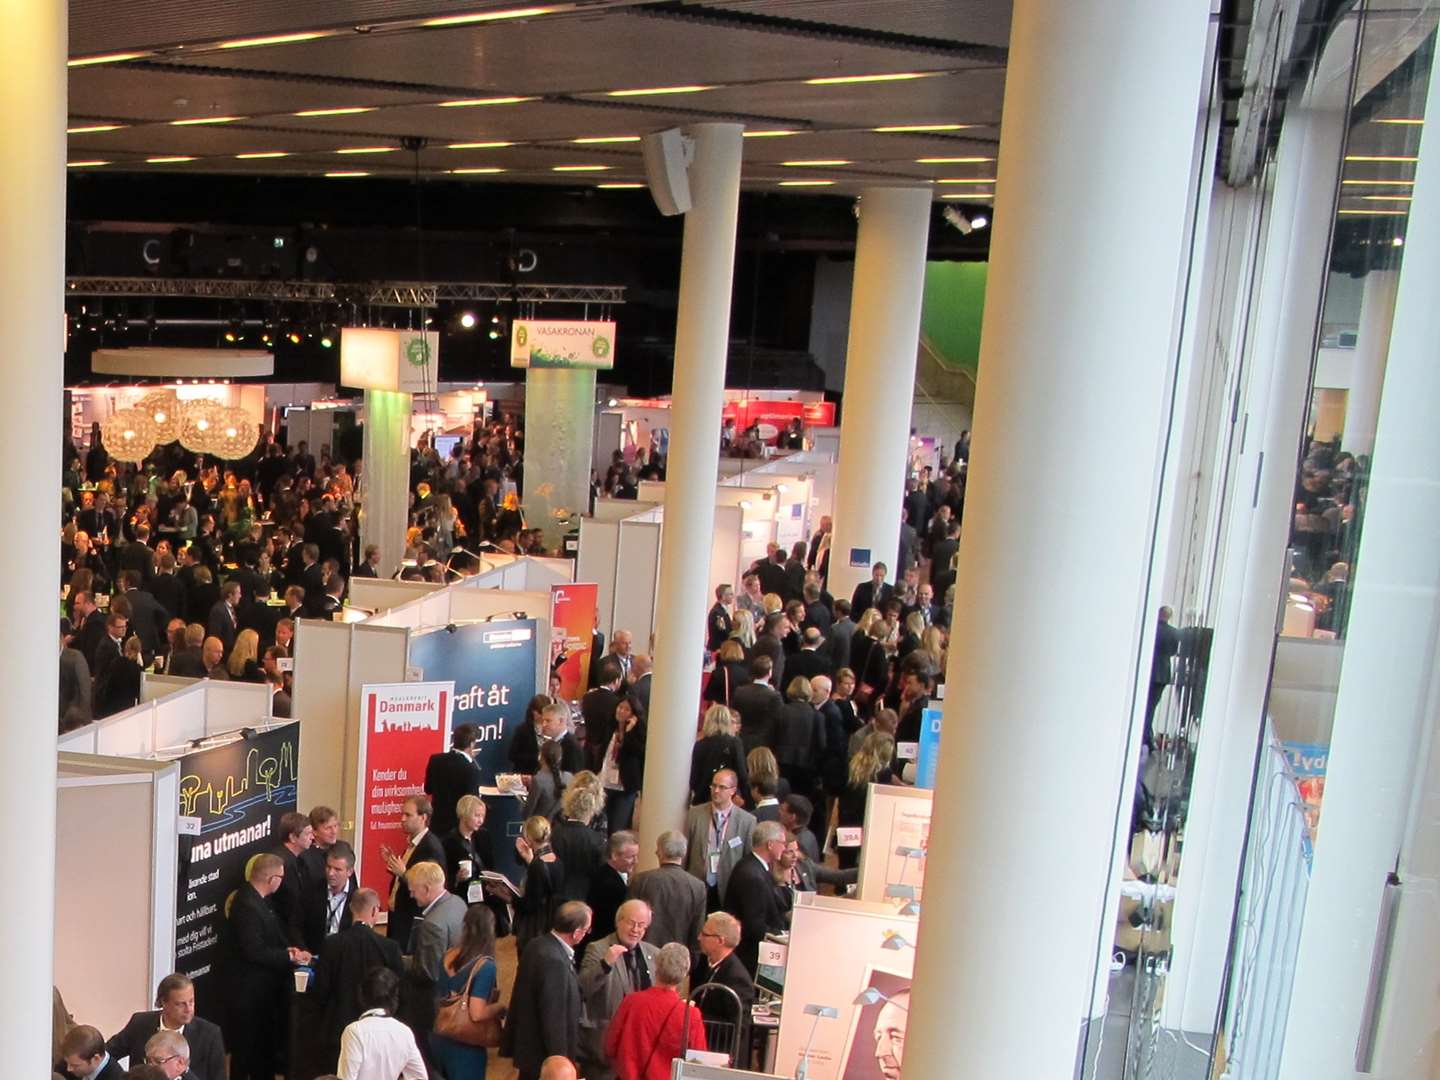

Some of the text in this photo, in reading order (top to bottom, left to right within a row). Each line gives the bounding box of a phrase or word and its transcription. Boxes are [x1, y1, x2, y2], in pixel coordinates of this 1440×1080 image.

[143, 239, 160, 264] C
[536, 327, 596, 336] VASAKRONAN
[452, 683, 510, 711] raft åt
[379, 699, 435, 713] Danmark
[372, 767, 407, 782] Kender du
[213, 814, 271, 855] utmanar!
[769, 951, 781, 960] 39
